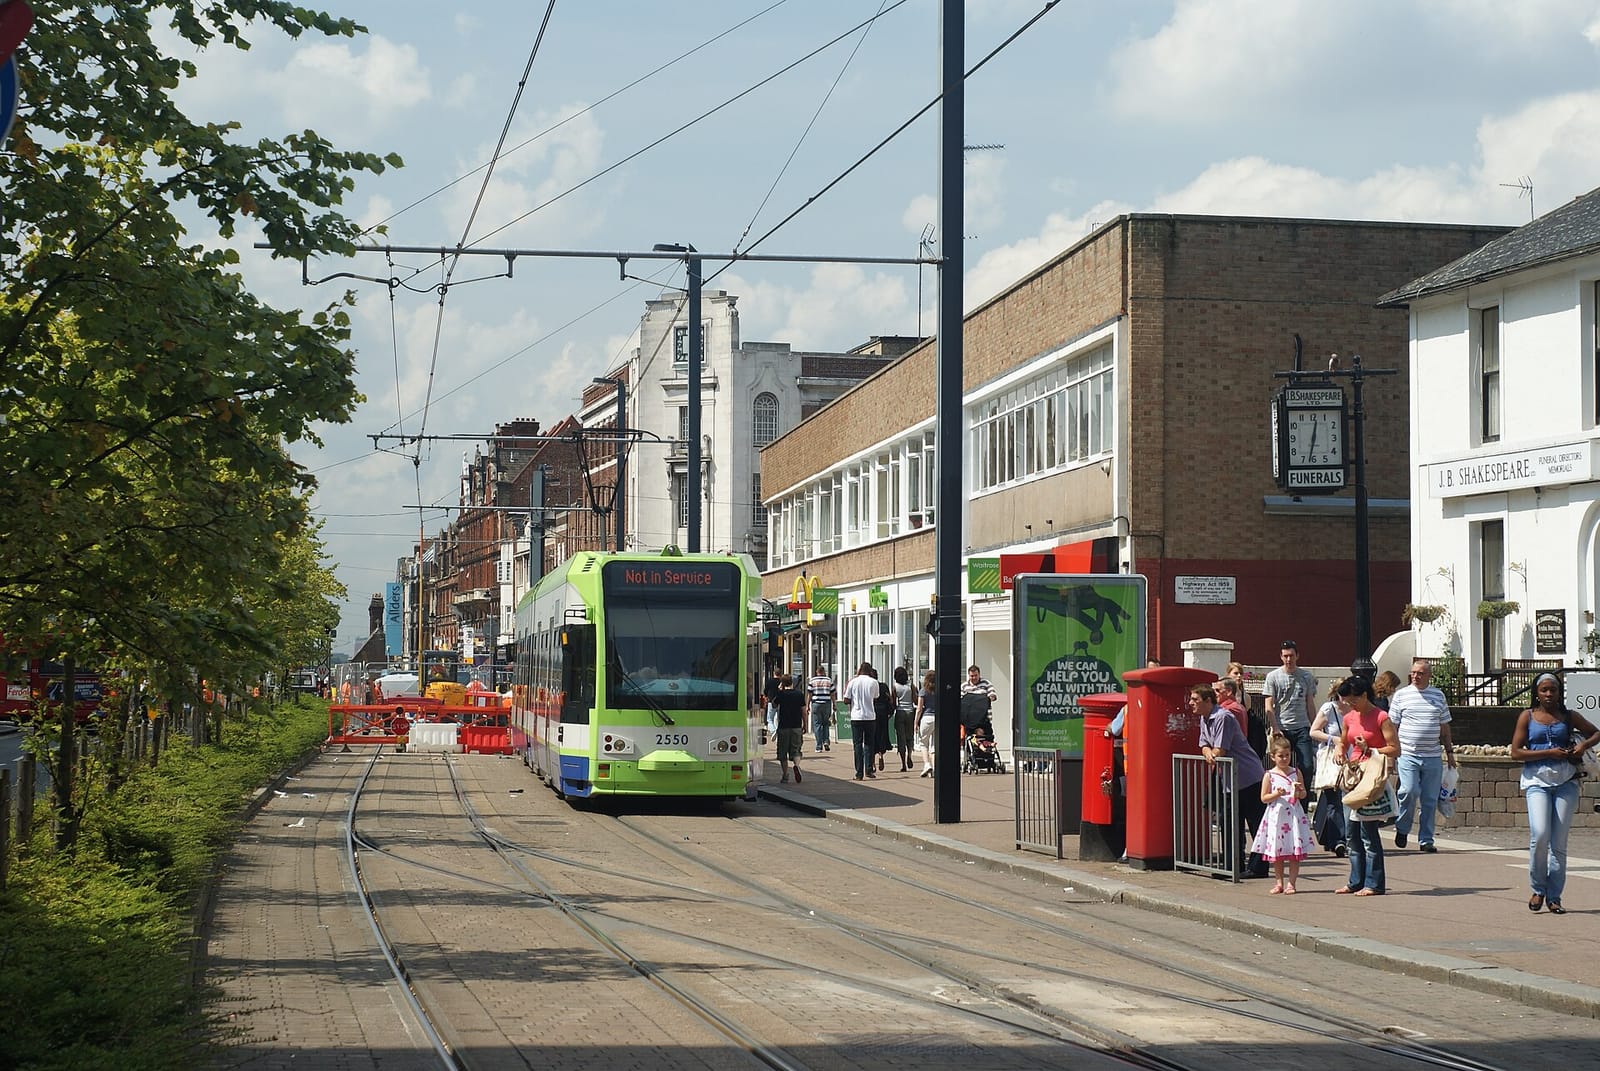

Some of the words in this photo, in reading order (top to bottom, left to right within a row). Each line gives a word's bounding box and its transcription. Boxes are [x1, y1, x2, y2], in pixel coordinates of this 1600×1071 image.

[1538, 454, 1557, 465] FUNERAL
[1290, 472, 1341, 484] FUNERALS
[1459, 458, 1530, 486] SHAKESPEARE
[625, 569, 647, 584] Not
[650, 570, 662, 584] in
[664, 569, 712, 585] Service
[390, 585, 401, 623] Allders
[1057, 661, 1073, 670] WE
[1075, 661, 1098, 670] CAN
[1047, 671, 1079, 683] HELP
[1080, 671, 1110, 683] YOU
[1036, 683, 1063, 693] DEAL
[1065, 683, 1094, 693] WITH
[1095, 683, 1117, 693] THE
[1576, 695, 1600, 710] SO
[1036, 706, 1071, 714] IMPACT
[655, 734, 689, 745] 2550
